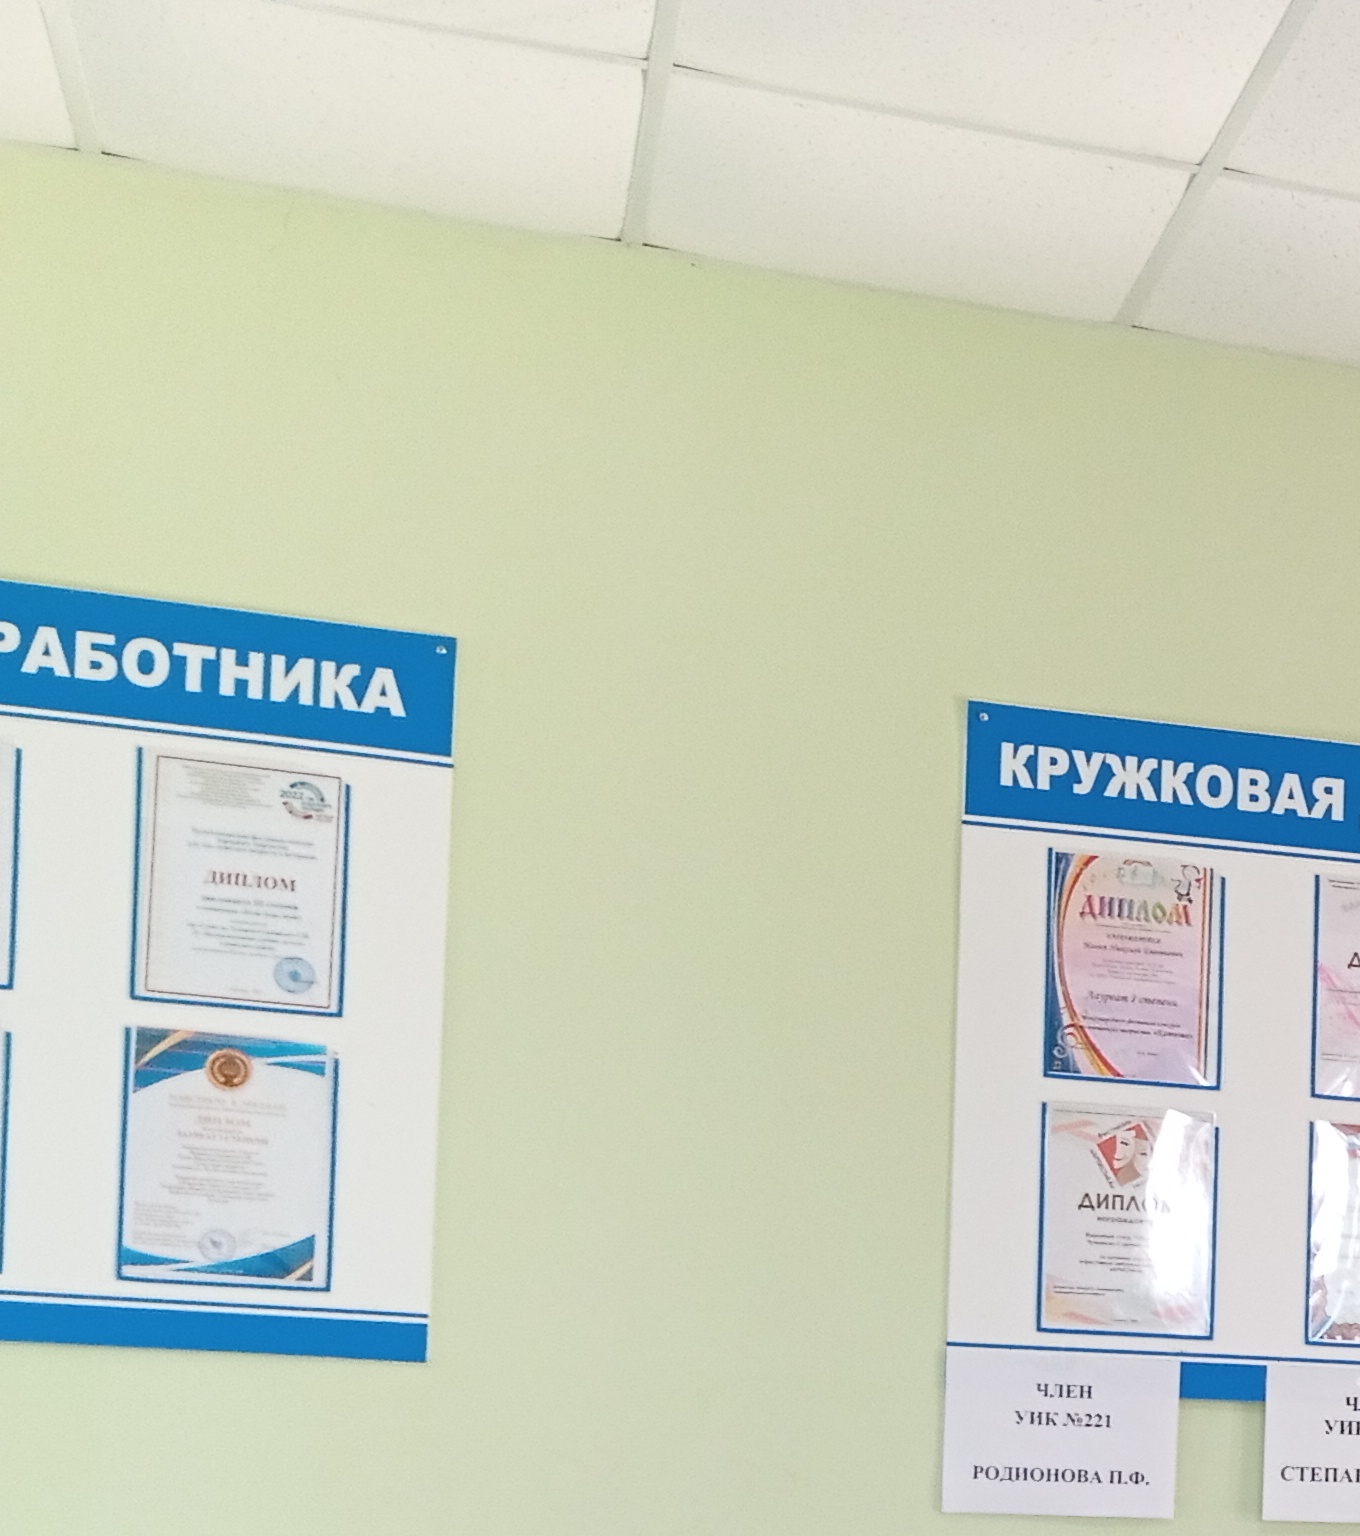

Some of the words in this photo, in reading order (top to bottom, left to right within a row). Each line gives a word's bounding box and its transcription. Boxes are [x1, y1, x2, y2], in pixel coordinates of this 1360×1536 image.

[999, 741, 1345, 821] КРУЖКОВАЯ
[202, 870, 297, 892] ДИПЛОМ
[1079, 894, 1193, 927] ДИПЛОМ
[1036, 1382, 1093, 1399] ЧЛЕН
[1014, 1410, 1059, 1427] УИК
[1062, 1412, 1112, 1428] №221
[972, 1464, 1103, 1484] РОДИОНОВА
[1108, 1470, 1151, 1486] П.Ф.
